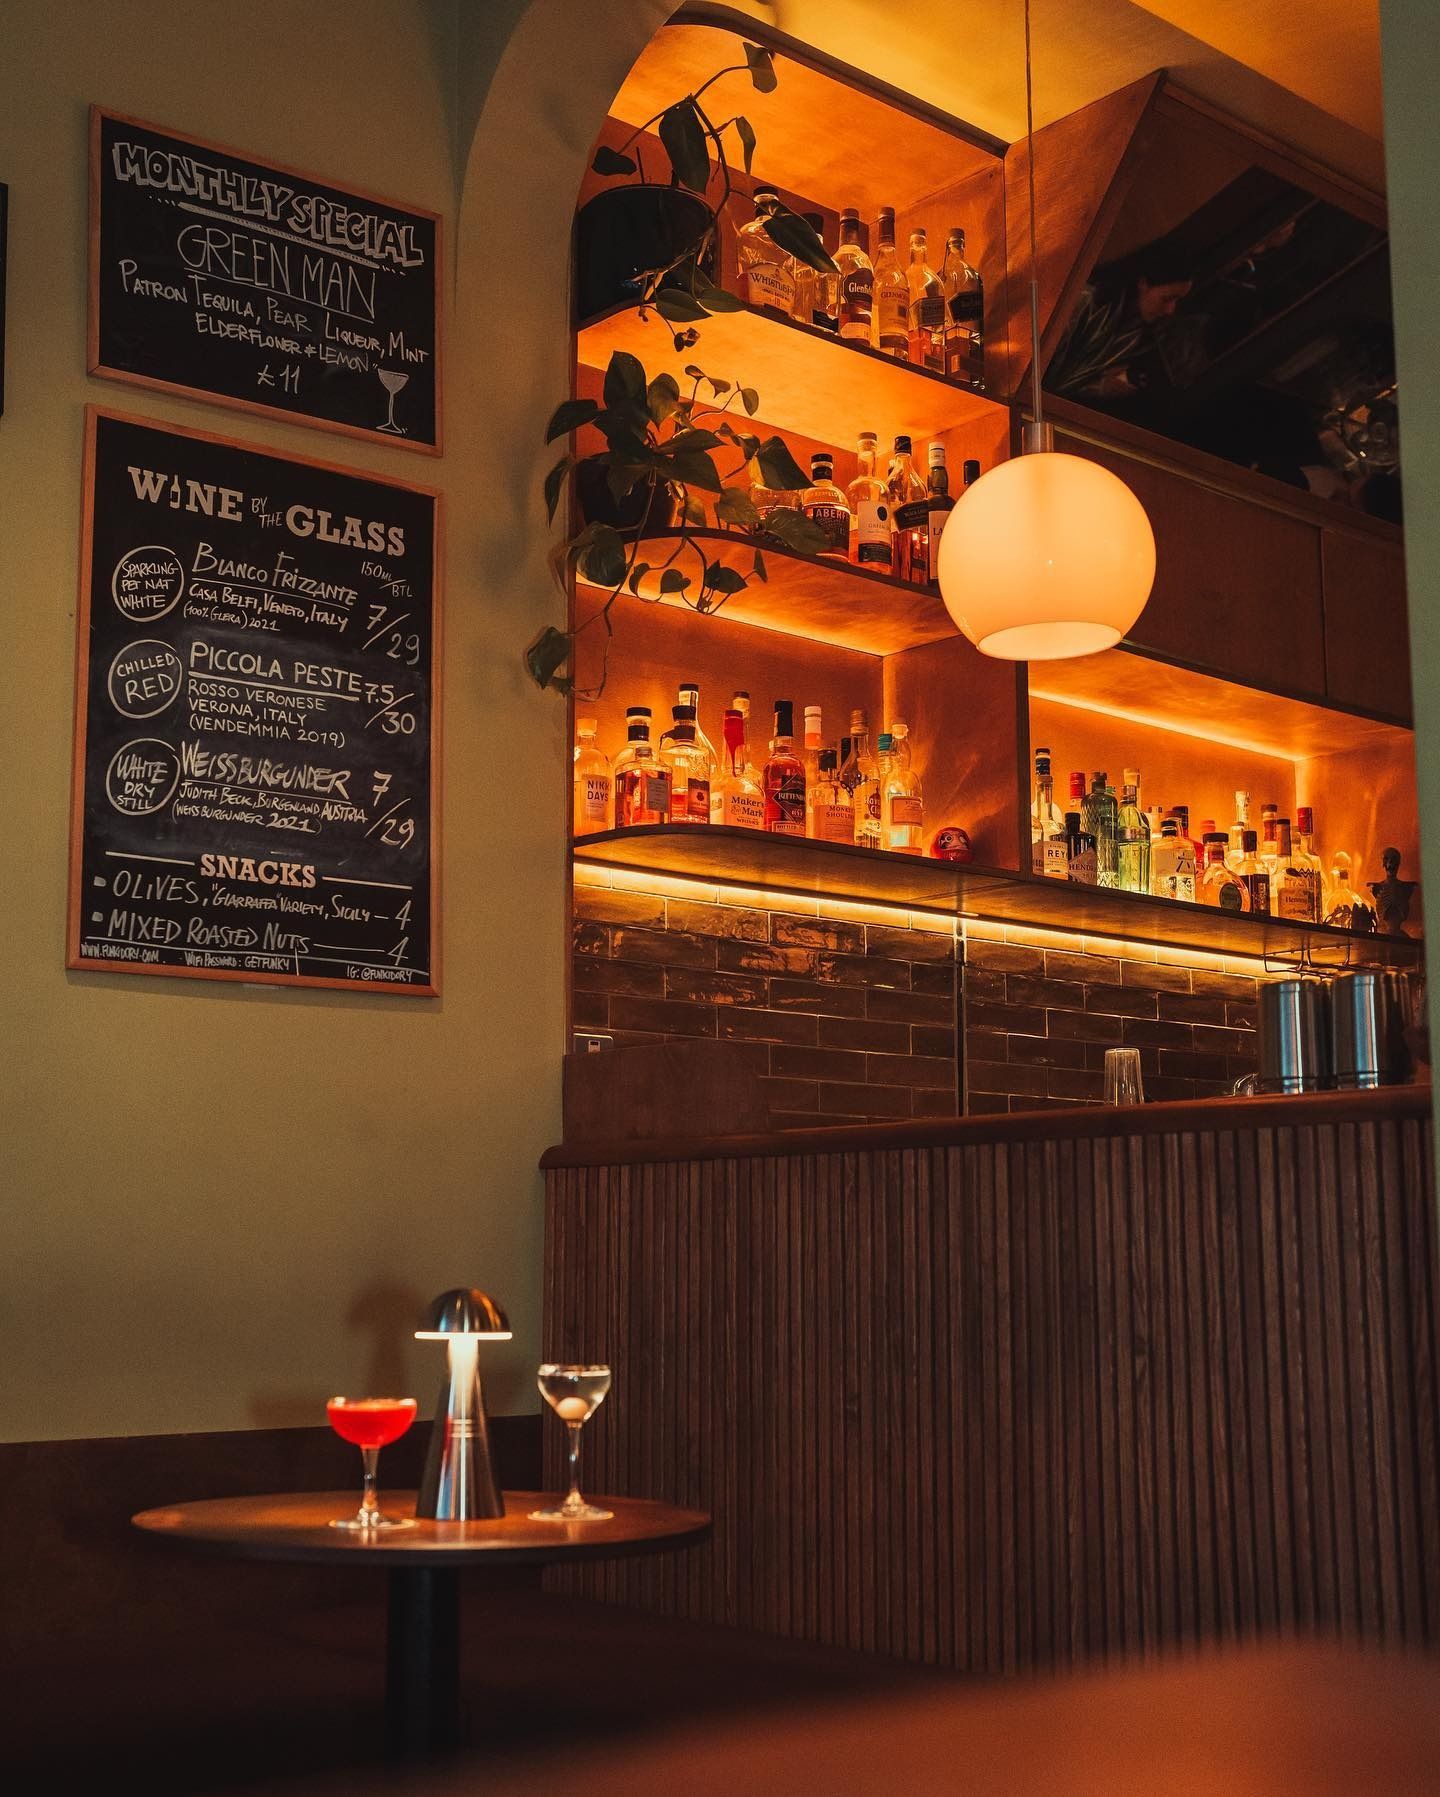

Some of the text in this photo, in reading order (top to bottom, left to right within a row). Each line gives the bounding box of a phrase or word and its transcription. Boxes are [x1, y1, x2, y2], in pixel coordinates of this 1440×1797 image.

[112, 142, 424, 266] MONTHLY SPECIAL
[177, 225, 376, 320] GREEN MAN
[196, 312, 302, 354] ELDERFLOWER
[319, 343, 369, 372] LEMON
[268, 296, 312, 332] PEAR
[389, 332, 429, 363] MINT
[127, 465, 406, 557] WINE BY THE GLASS
[120, 578, 175, 592] PET NAT
[120, 594, 166, 610] WHITE
[188, 582, 218, 603] CASA
[310, 603, 349, 633] ITALY
[249, 617, 281, 632] 2021
[116, 652, 176, 678] CHILLED
[189, 641, 362, 693] PICCOLA PESTE
[125, 673, 174, 704] RED
[188, 678, 328, 712] ROSSO VERONESE
[189, 713, 345, 749] (VENDEMMIA 2019)
[263, 707, 307, 726] ITALY
[116, 753, 169, 784] WHITE
[117, 794, 153, 810] STILL
[124, 781, 156, 798] DRY
[587, 791, 609, 802] DAYS
[742, 807, 763, 818] Mark
[200, 853, 316, 889] SNACKS
[331, 894, 370, 923] SICILY
[395, 900, 412, 931] 4
[107, 908, 409, 966] MIXED ROASTED NUTS 4
